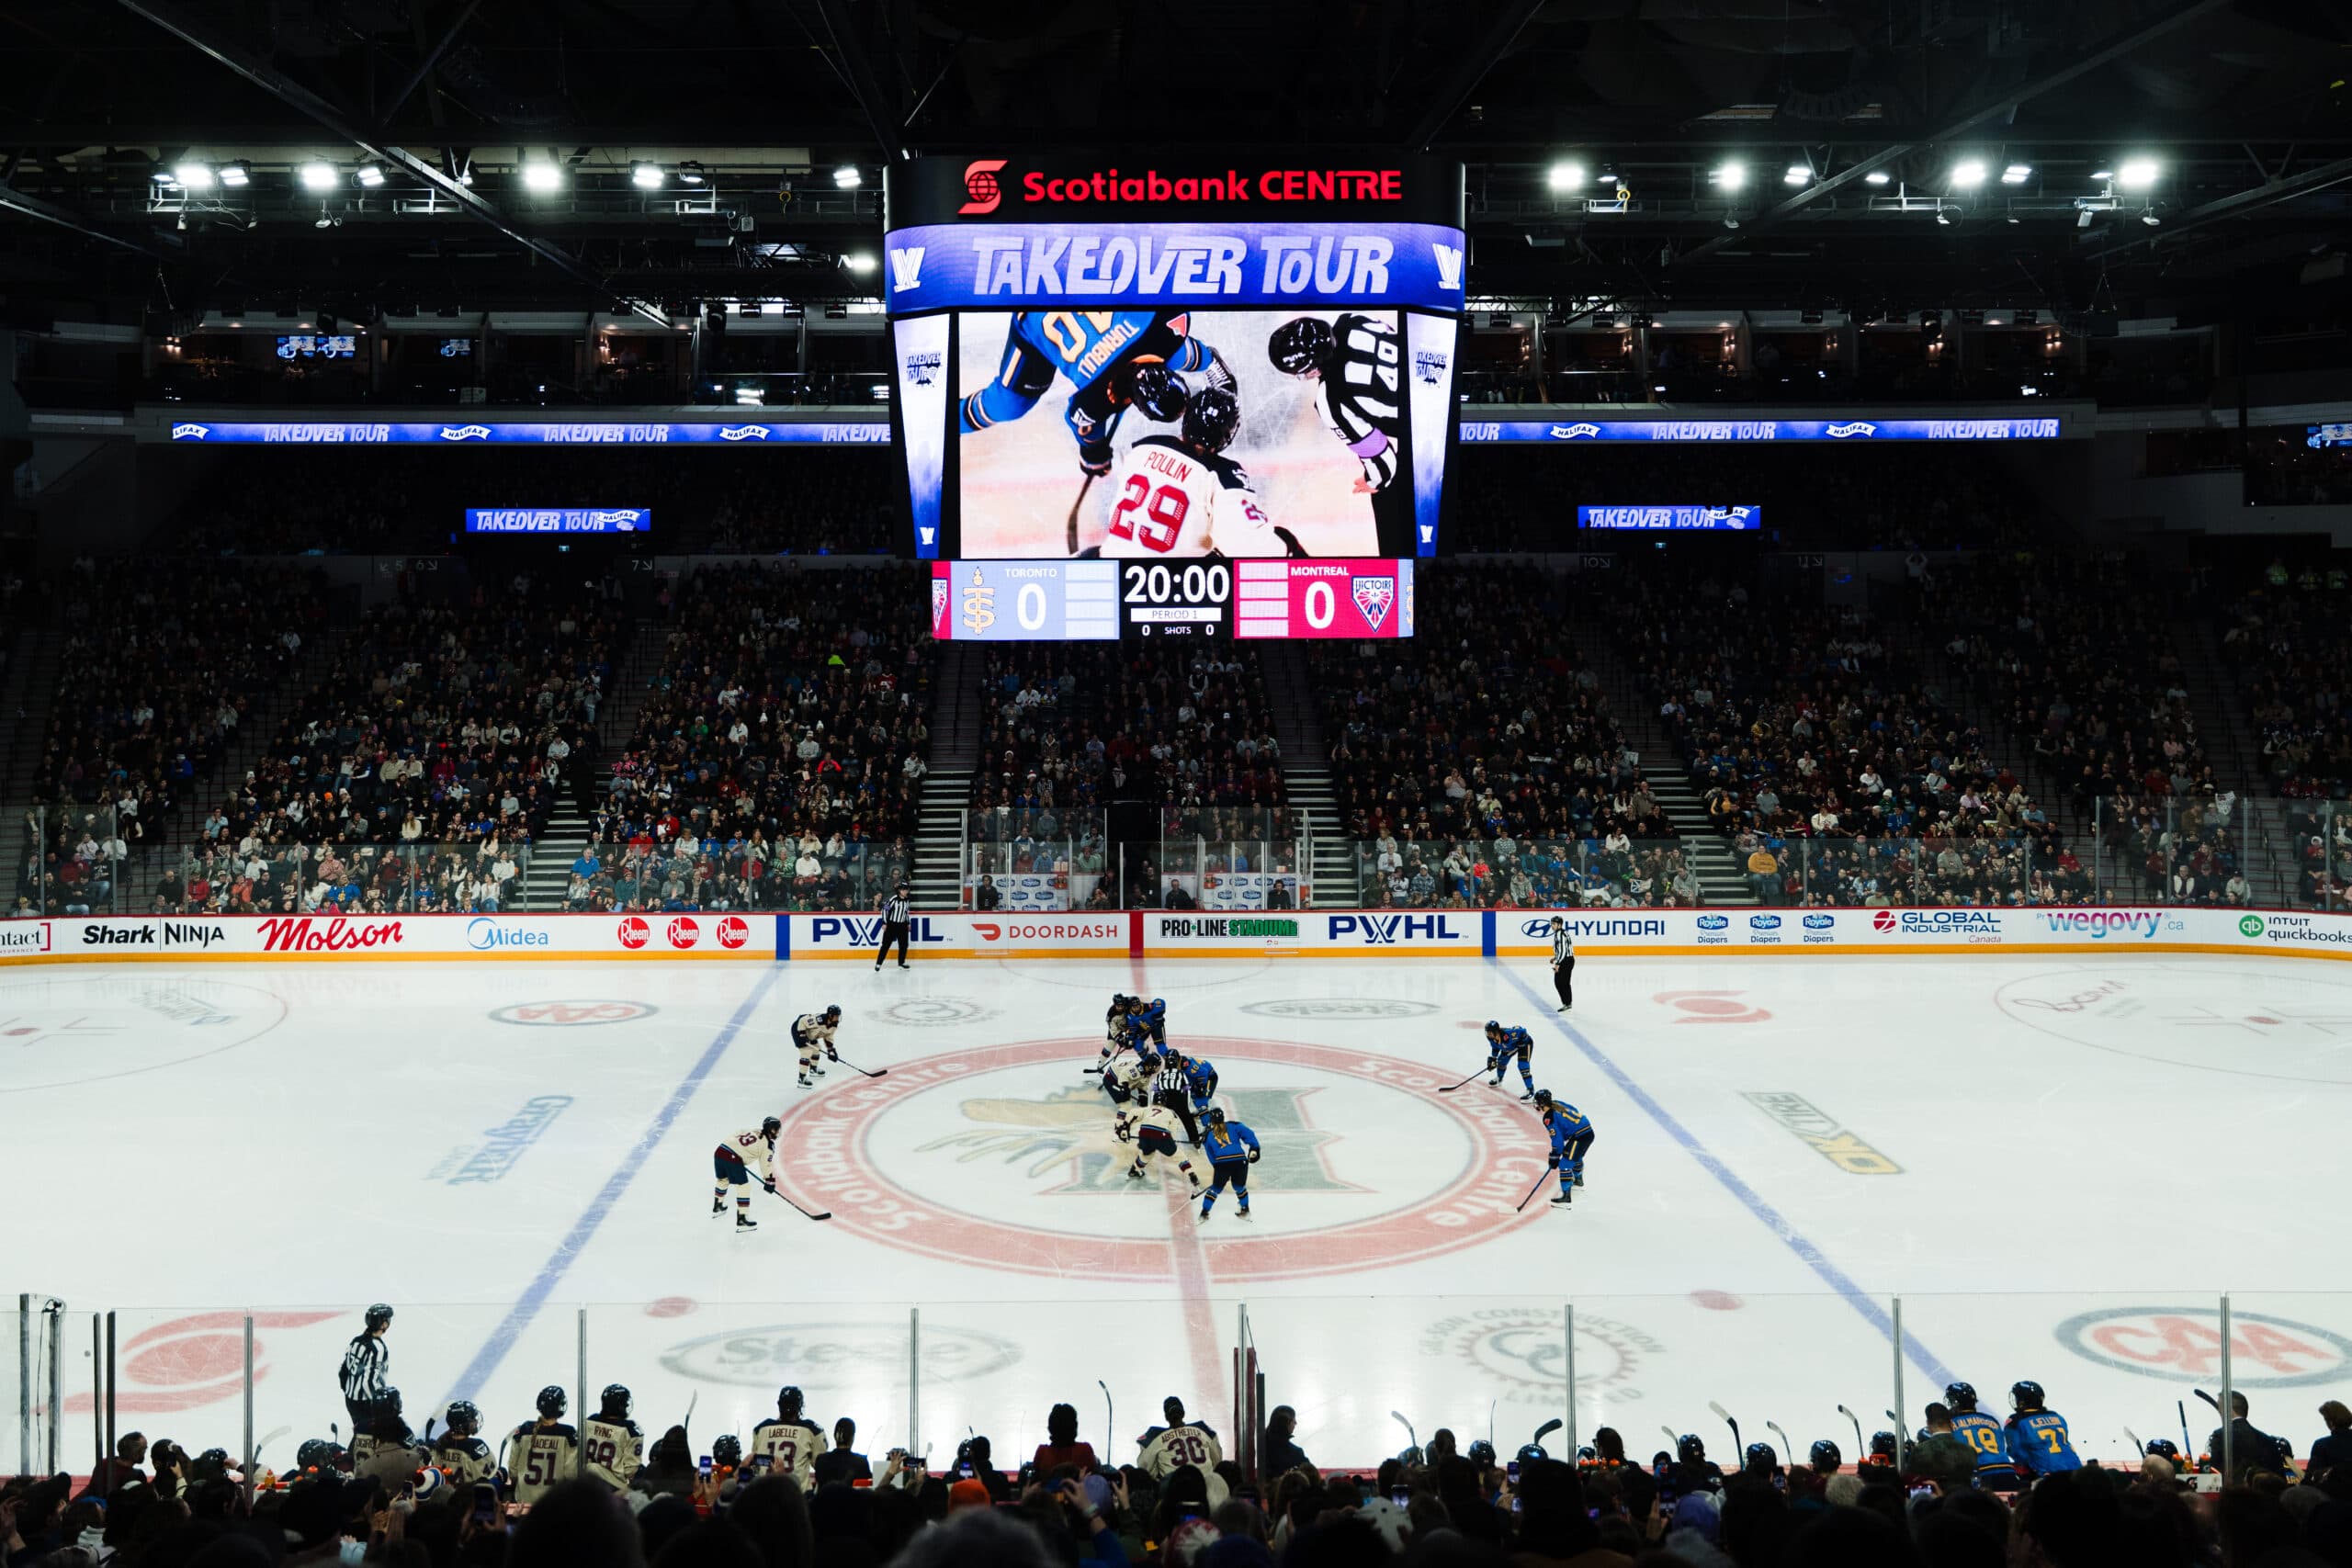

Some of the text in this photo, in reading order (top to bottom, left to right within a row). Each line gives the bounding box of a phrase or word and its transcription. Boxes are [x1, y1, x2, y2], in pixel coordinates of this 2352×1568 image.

[1023, 170, 1401, 201] Scotiabank CENTRE
[973, 236, 1247, 294] TAKEOVER
[1077, 319, 1140, 379] TURNBULL
[264, 424, 344, 441] TAKEOVER
[447, 426, 485, 439] HALIFAX
[544, 424, 624, 442] TAKEOVER
[727, 426, 763, 439] HALIFAX
[1557, 426, 1594, 437] HALIFAX
[1652, 423, 1732, 440] TAKEOVER
[1833, 425, 1871, 436] HALIFAX
[1928, 421, 2009, 438] TAKEOVER
[1145, 451, 1193, 483] POULIN
[476, 511, 560, 530] TAKEOVER
[602, 512, 635, 522] HALIFAX
[1109, 473, 1190, 553] 29
[1588, 508, 1671, 527] TAKEOVER
[1005, 569, 1057, 578] TORONTO
[1291, 566, 1349, 576] MONTREAL
[1125, 565, 1229, 603] 20:00
[1017, 583, 1046, 630] 0
[1305, 581, 1335, 629] 0
[1151, 610, 1190, 619] PERIOD
[1142, 625, 1214, 637] 0 SHOTS 0
[1700, 918, 1726, 929] Royale
[1752, 918, 1780, 929] Royale
[1804, 917, 1832, 928] Royale
[1902, 912, 2001, 924] GLOBAL
[2047, 912, 2162, 939] wegovy
[83, 921, 224, 948] Shark NINJA
[257, 919, 403, 951] Molson
[620, 918, 650, 945] Rheem
[670, 918, 698, 945] Rheem
[719, 918, 748, 945] Rheem
[1009, 925, 1118, 940] DOORDASH
[1329, 916, 1460, 944] PWHL
[1565, 920, 1666, 936] HYUNDAI
[1902, 924, 2001, 933] INDUSTRIAL
[2267, 929, 2352, 944] quickbooks
[482, 929, 548, 946] Midea
[1750, 935, 1781, 943] Diapers
[1804, 935, 1834, 943] Diapers
[1969, 935, 2001, 943] Canada
[823, 1061, 970, 1112] Centre
[793, 1120, 927, 1233] Scotiabank
[2092, 1316, 2340, 1374] CAA
[768, 1427, 798, 1438] LABELLE
[1168, 1436, 1206, 1466] 30
[524, 1450, 557, 1485] 51
